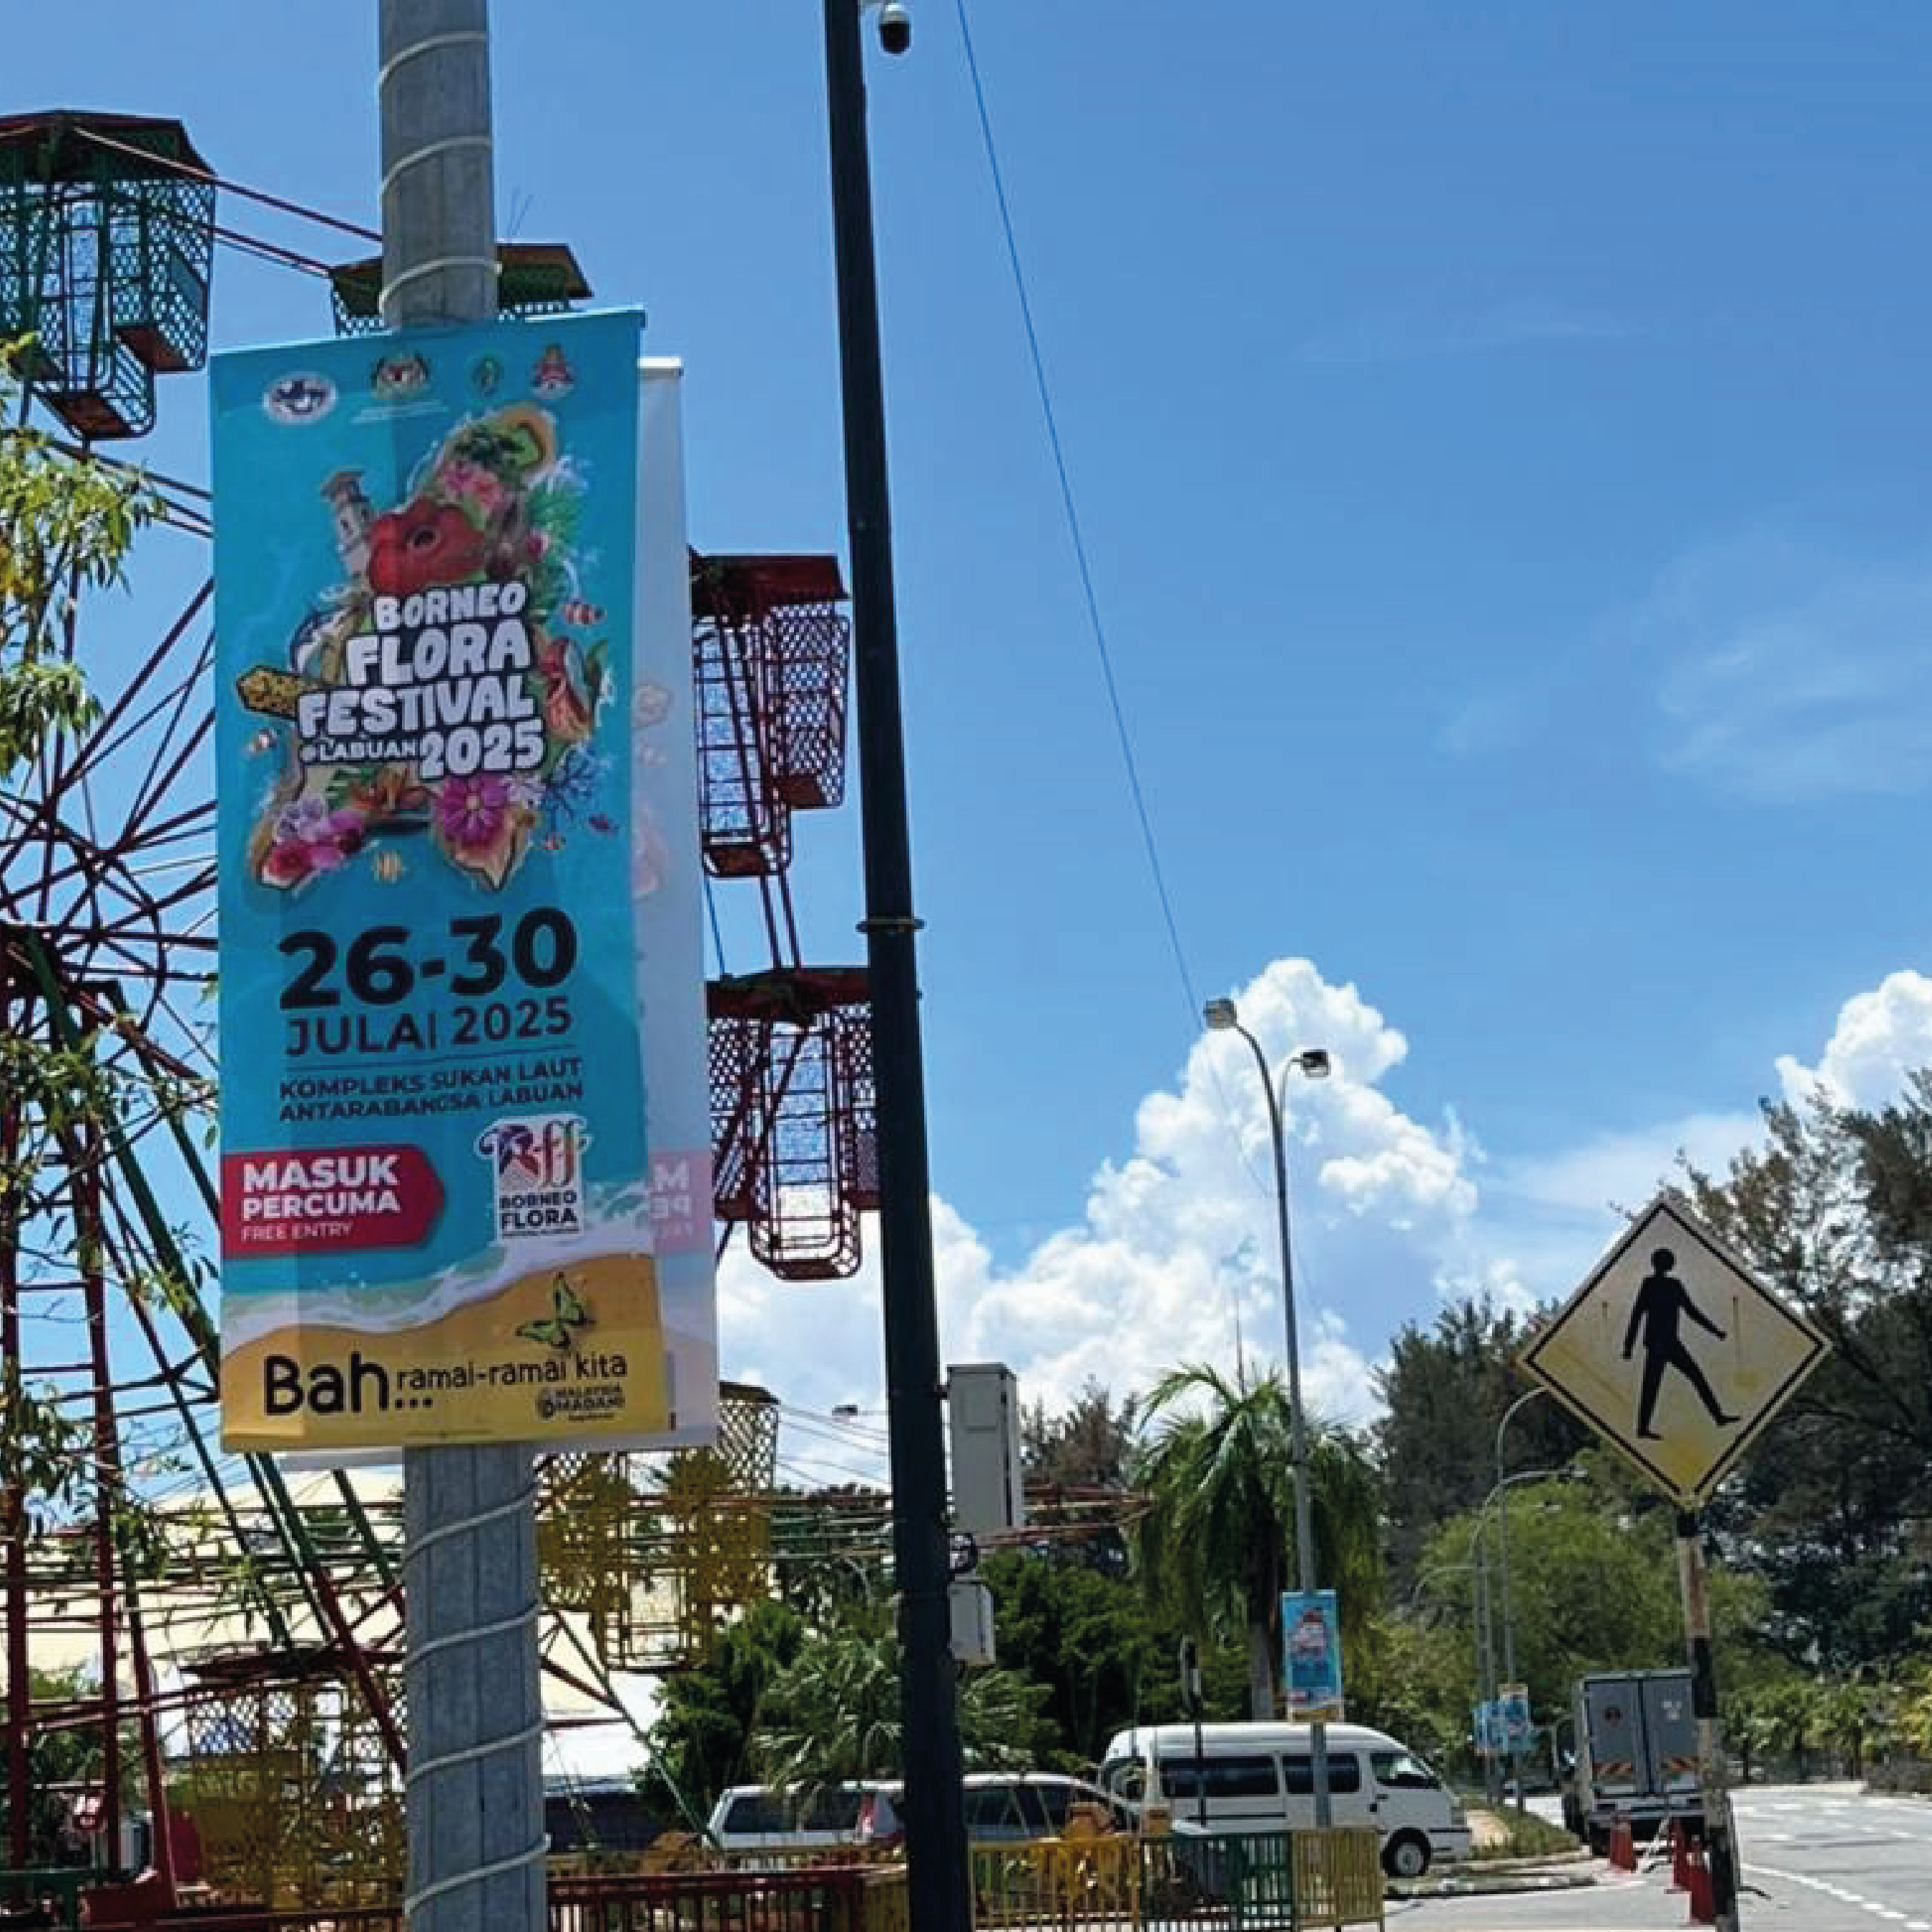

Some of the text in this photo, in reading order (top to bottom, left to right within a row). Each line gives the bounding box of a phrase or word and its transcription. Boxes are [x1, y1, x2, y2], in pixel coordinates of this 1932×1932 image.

[376, 582, 528, 630] BORNEO
[348, 619, 531, 685] FLORA
[299, 675, 534, 737] FESTIVAL
[419, 718, 544, 779] 2025
[280, 907, 577, 1009] 26-30
[286, 996, 571, 1056] JULAI 2025
[280, 1056, 582, 1099] KOMPLEKS SUKAN LAUT
[280, 1082, 582, 1121] ANTARABANGSA LABUAN
[243, 1154, 401, 1192] MASUK
[242, 1190, 402, 1221] PERCUMA
[499, 1190, 577, 1209] BORNEO
[501, 1207, 578, 1230] FLORA
[240, 1221, 353, 1242] FREE ENTRY
[396, 1361, 567, 1390] ramai-ramai
[575, 1351, 628, 1381] kita
